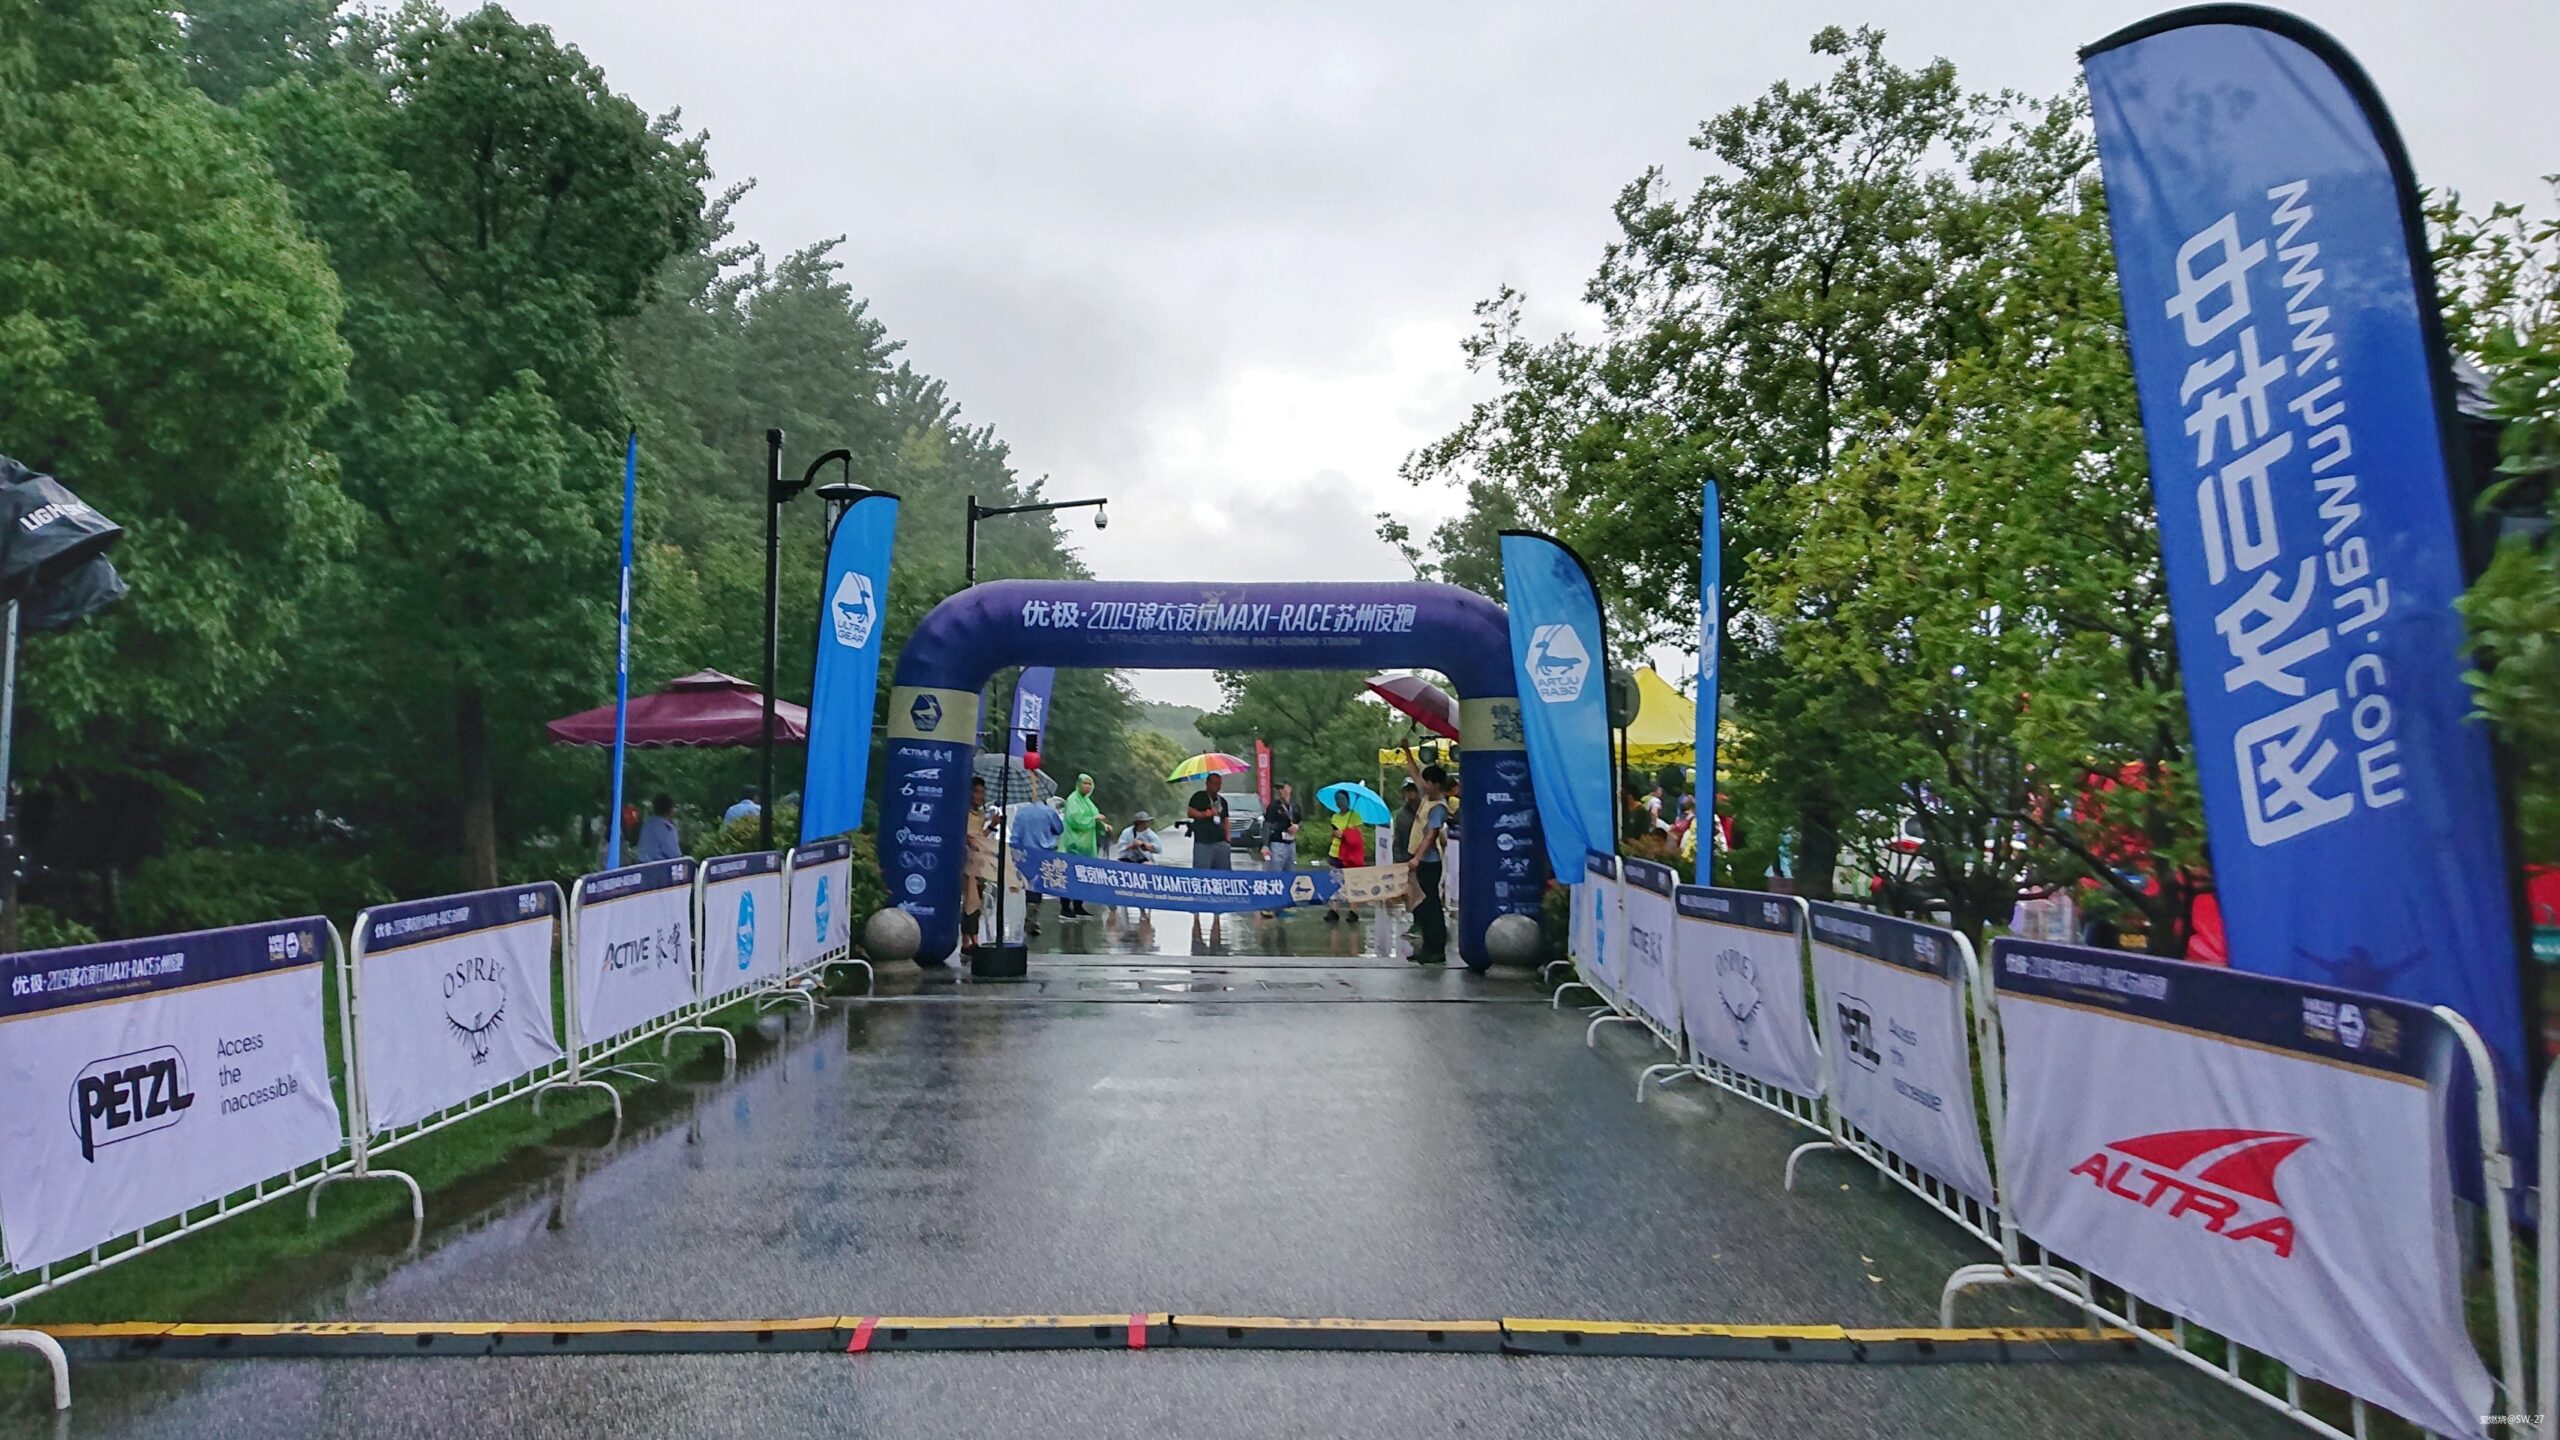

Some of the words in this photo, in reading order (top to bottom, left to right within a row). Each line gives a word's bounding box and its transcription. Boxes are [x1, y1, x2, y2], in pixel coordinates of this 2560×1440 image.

[837, 619, 867, 634] ULTRA
[837, 630, 864, 642] GEAR
[911, 803, 931, 814] LP
[908, 833, 943, 843] EVCARD
[601, 936, 650, 972] ACTIVE
[217, 1034, 264, 1058] Access
[219, 1065, 242, 1087] the
[221, 1074, 298, 1116] inaccessible
[78, 1057, 195, 1163] PETZL
[2070, 1153, 2296, 1258] ALTRA
